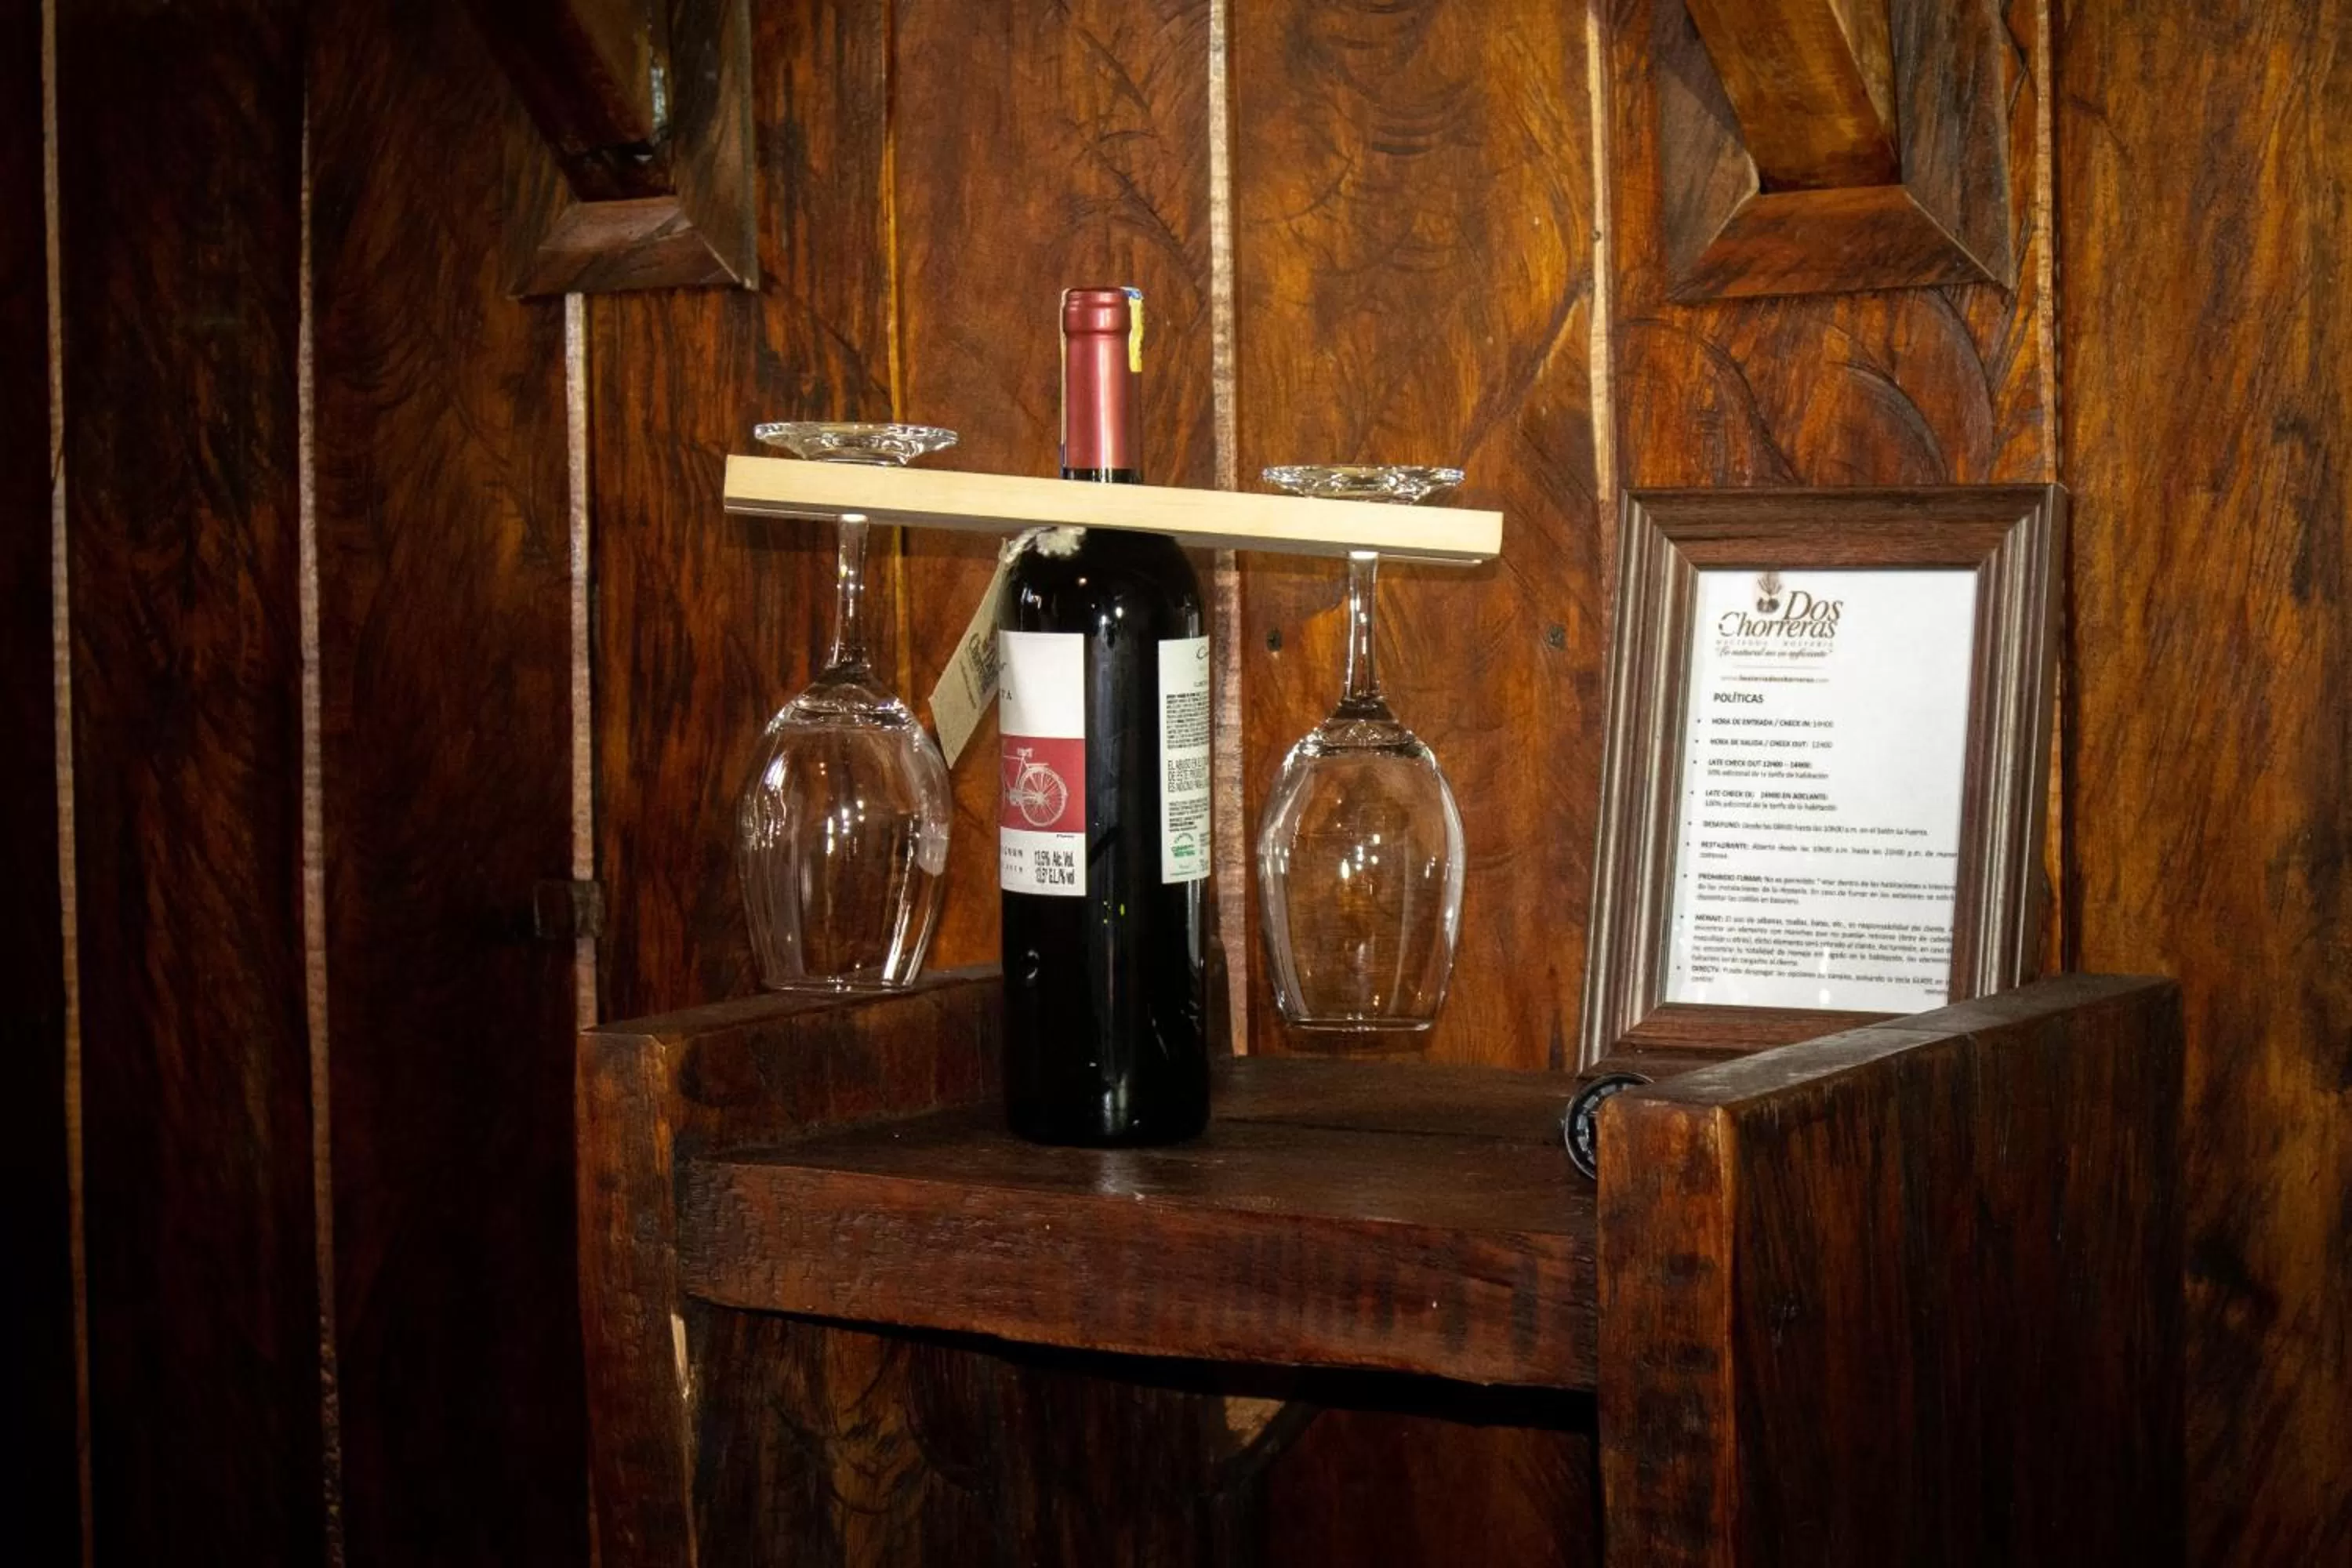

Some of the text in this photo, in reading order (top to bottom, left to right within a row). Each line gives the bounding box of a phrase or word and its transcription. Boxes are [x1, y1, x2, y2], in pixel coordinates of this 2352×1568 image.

[1782, 590, 1843, 621] Dos
[1718, 612, 1837, 639] Chorreras
[1714, 691, 1764, 703] POLÍTICAS
